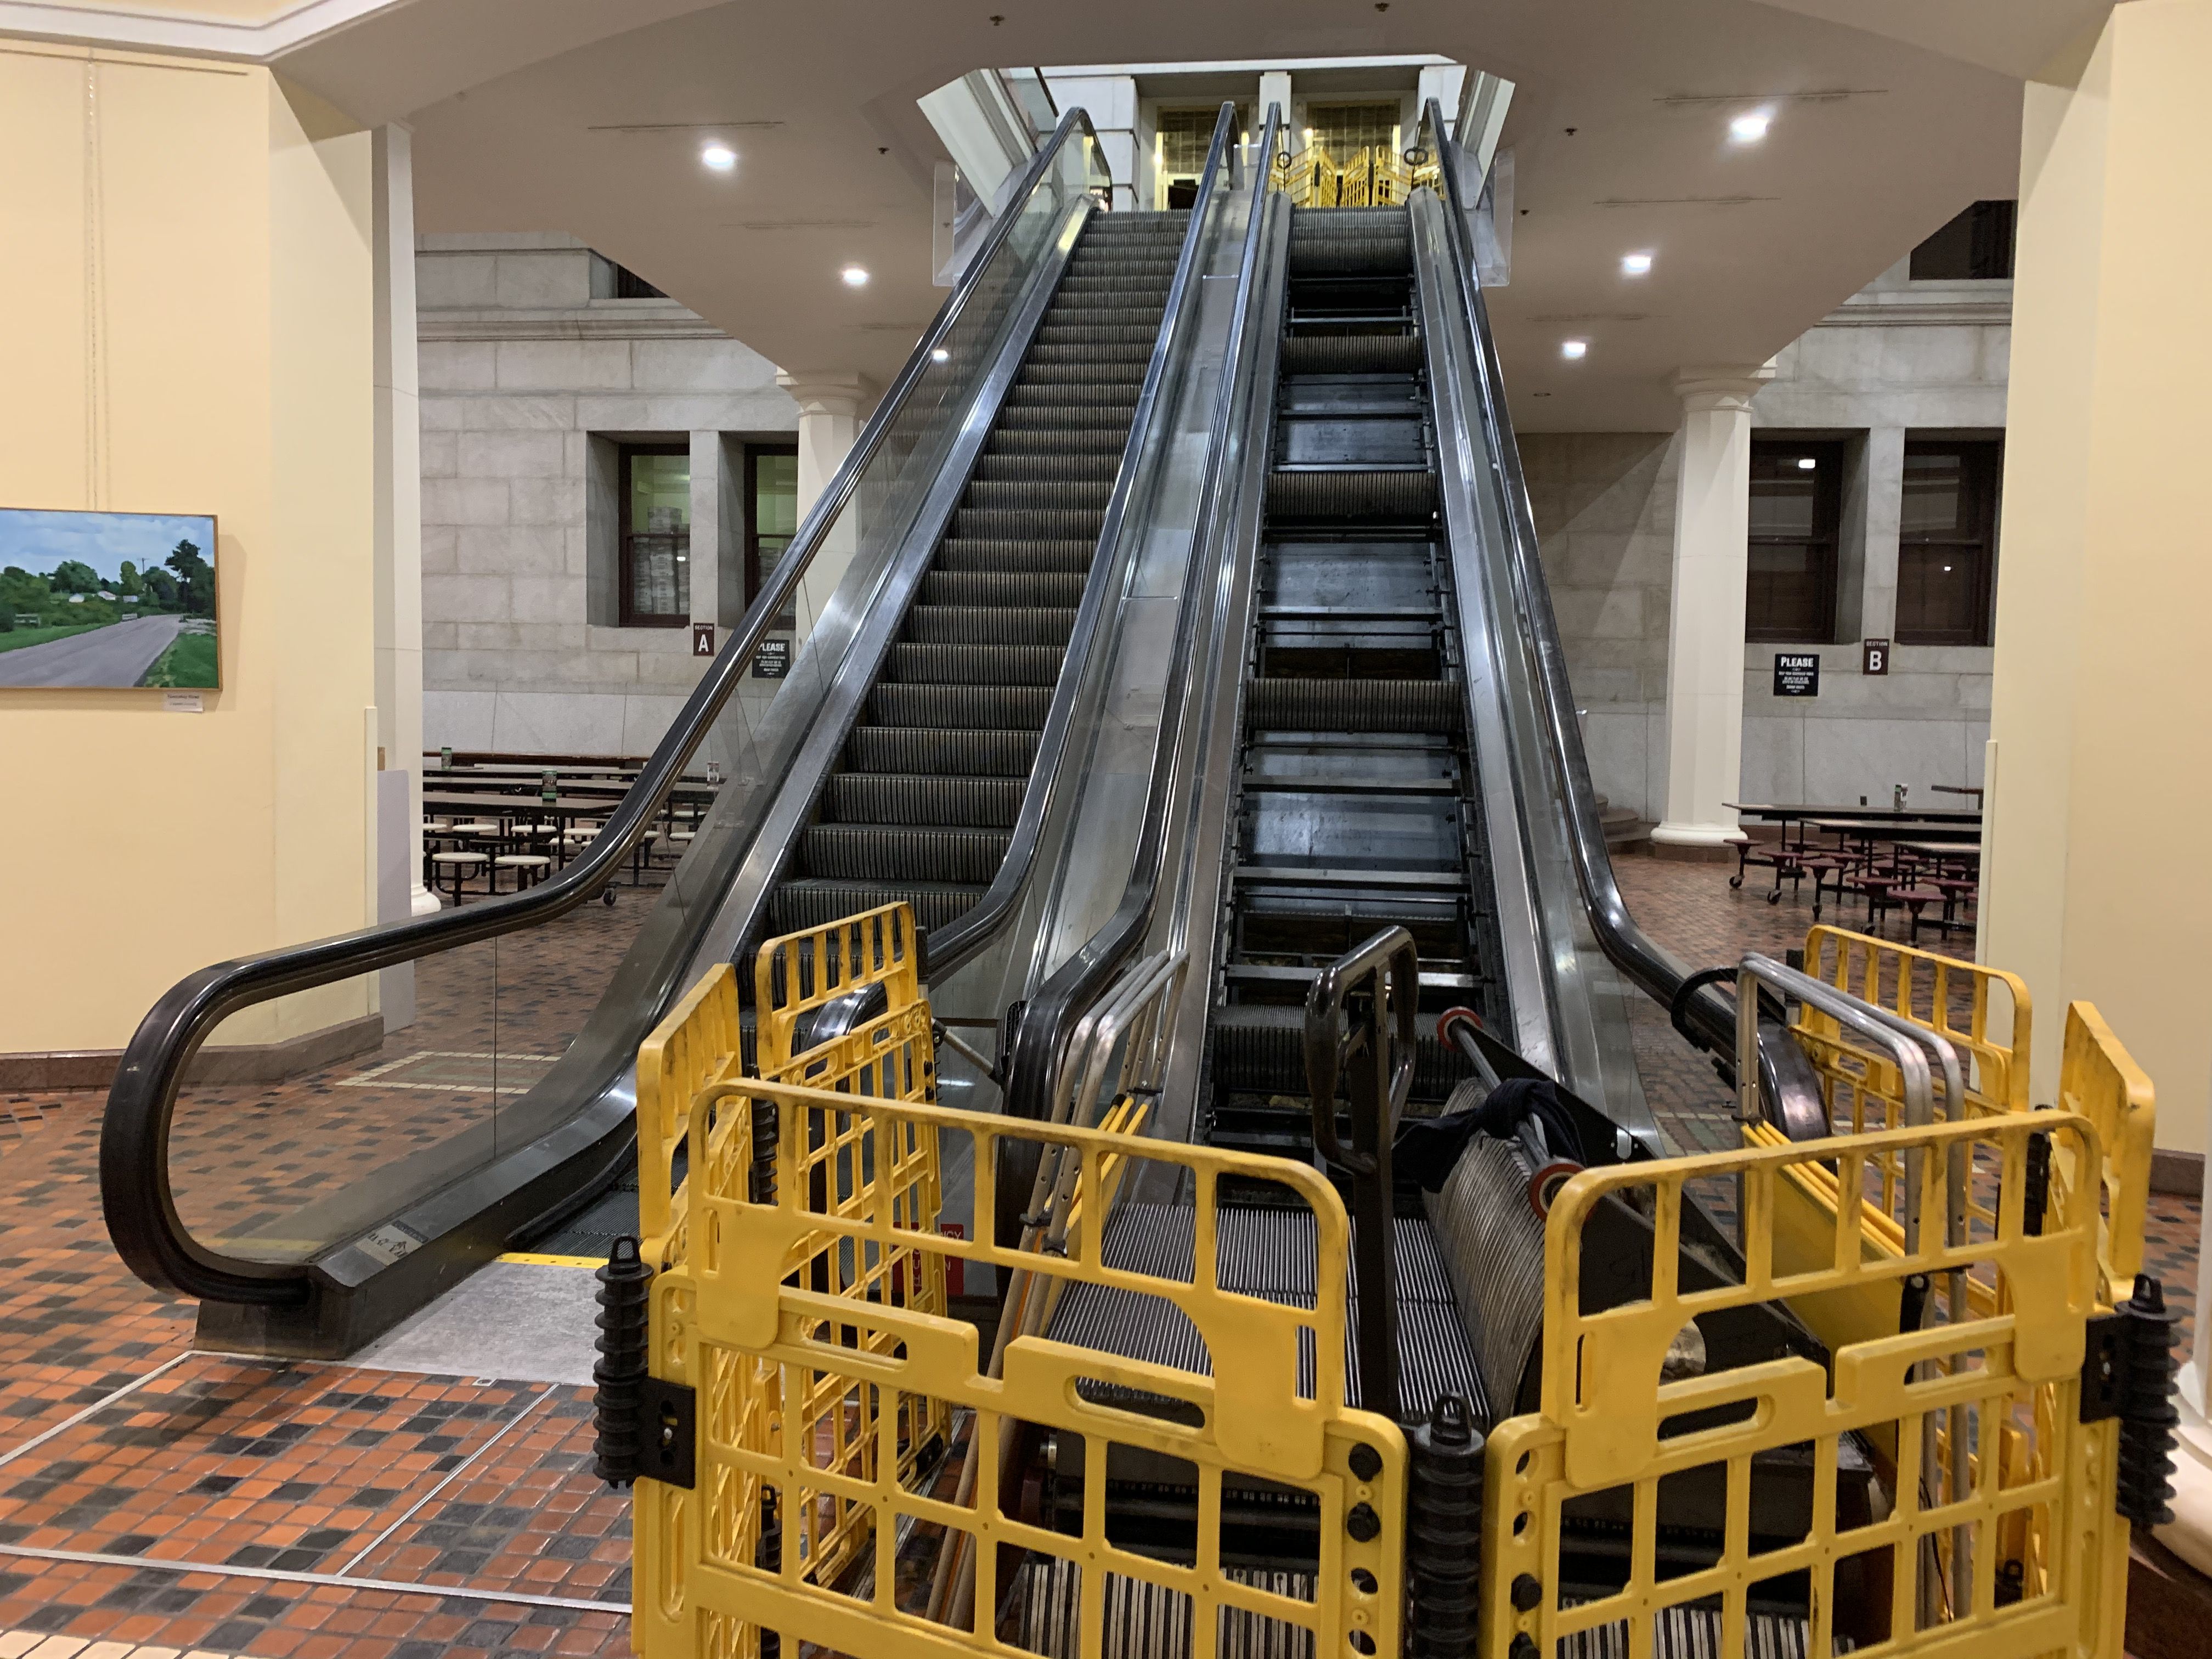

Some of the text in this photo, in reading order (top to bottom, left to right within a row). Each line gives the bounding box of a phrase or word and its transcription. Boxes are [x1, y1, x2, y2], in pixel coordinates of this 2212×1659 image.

[698, 634, 709, 652] A
[1781, 656, 1814, 667] PLEASE
[1870, 650, 1882, 670] B
